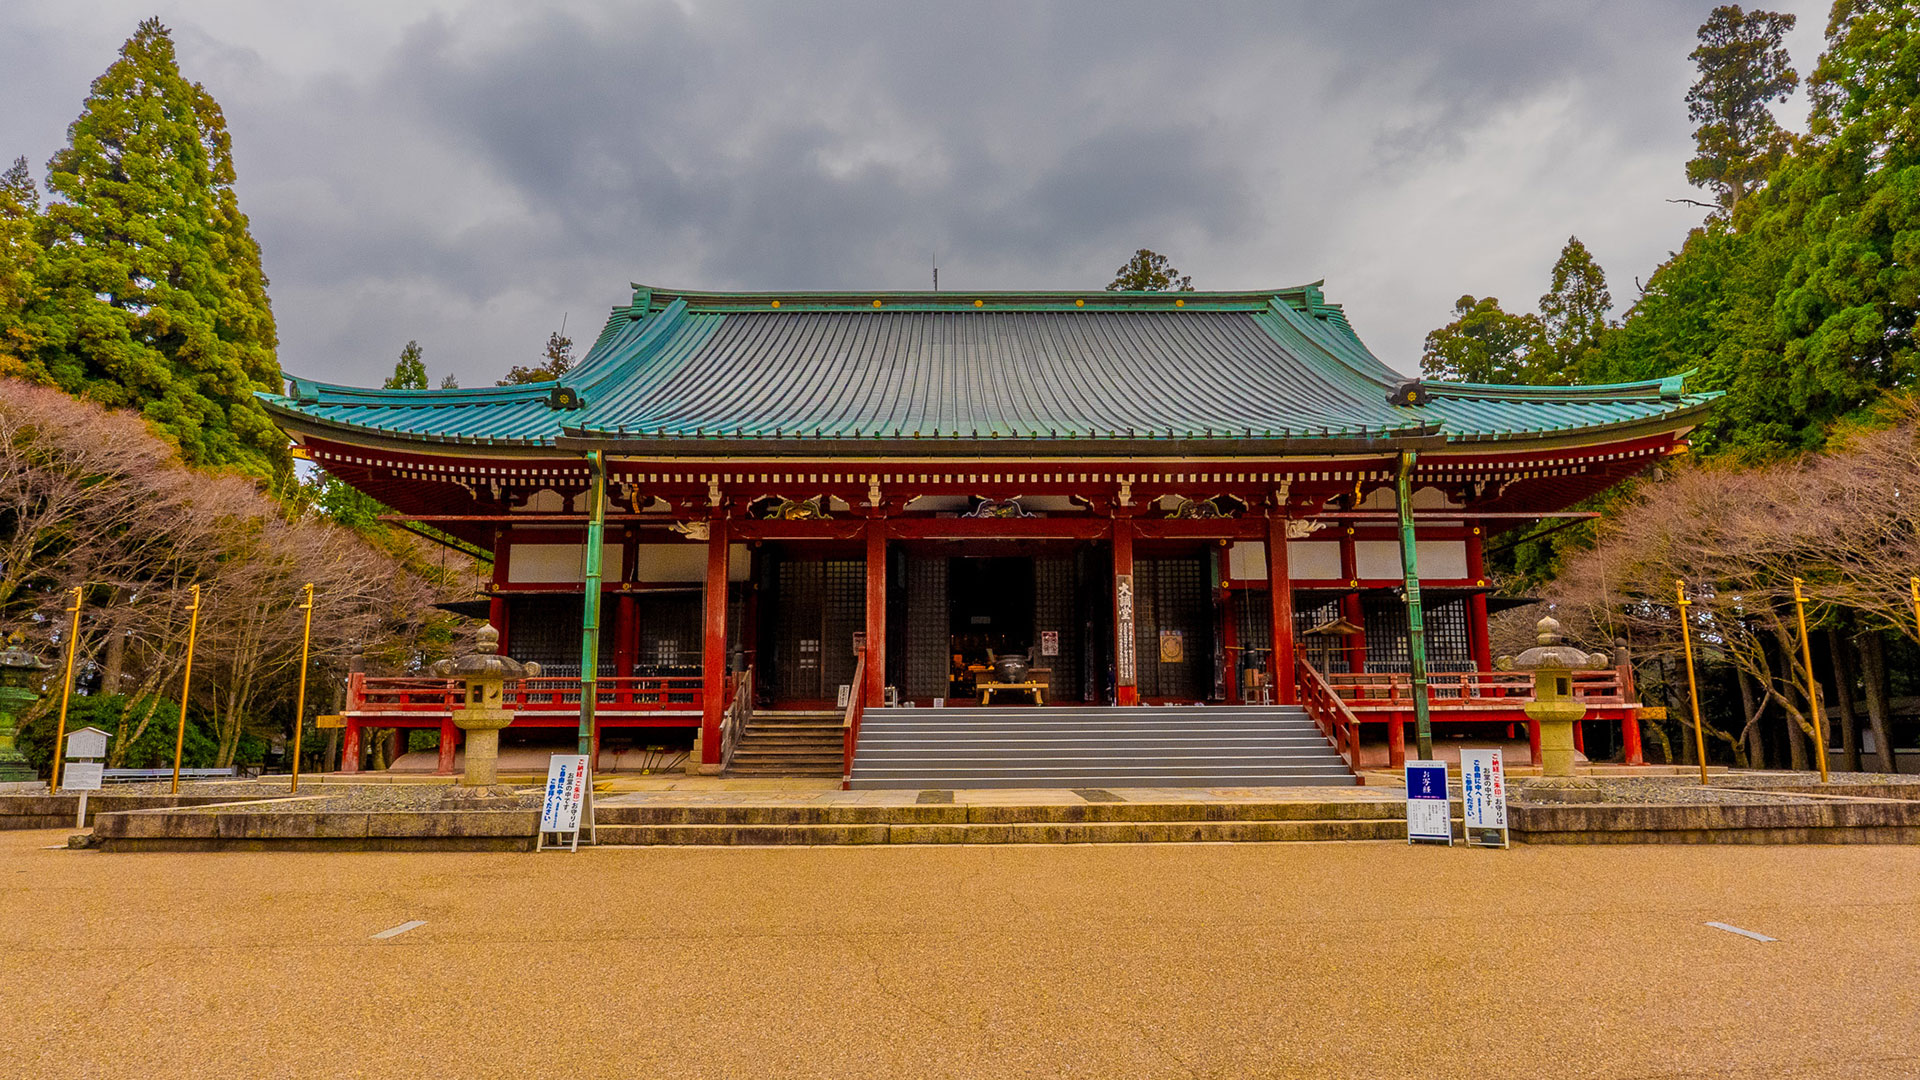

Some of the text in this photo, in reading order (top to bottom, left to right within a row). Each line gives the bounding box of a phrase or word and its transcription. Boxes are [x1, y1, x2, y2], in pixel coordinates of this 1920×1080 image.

[555, 764, 567, 802] ご自由に中へ
[1473, 759, 1483, 797] ご自由に中へ
